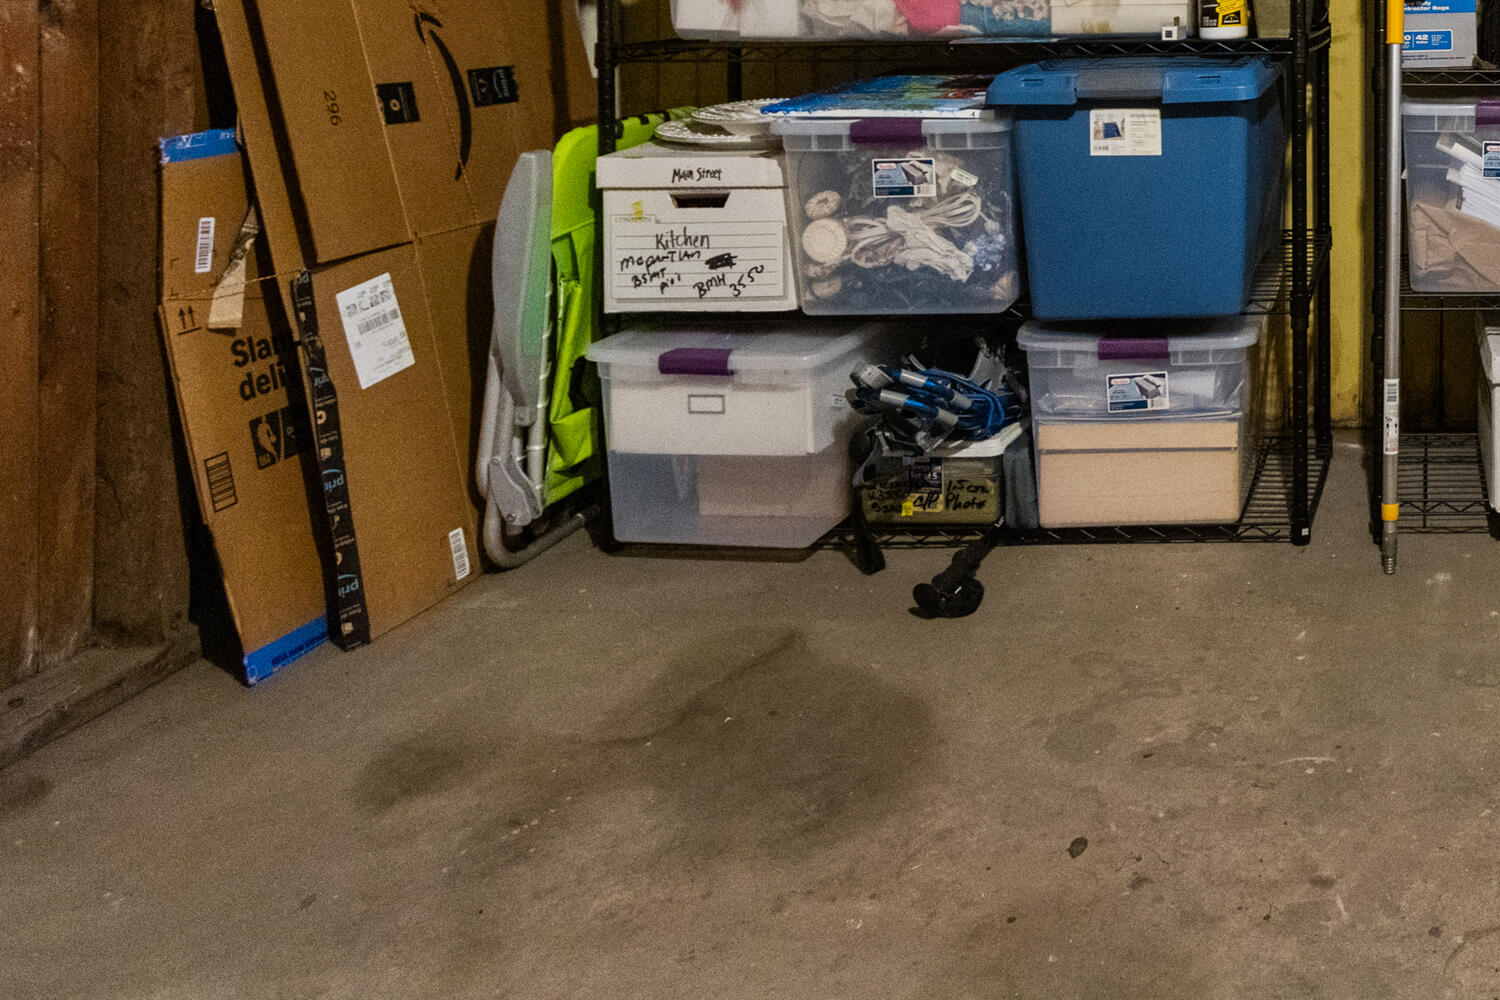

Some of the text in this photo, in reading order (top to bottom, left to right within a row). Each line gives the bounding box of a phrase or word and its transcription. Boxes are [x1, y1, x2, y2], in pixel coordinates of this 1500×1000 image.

[324, 89, 342, 127] 296
[672, 167, 722, 184] Main Street
[655, 227, 710, 250] Kitchen
[239, 362, 286, 402] deli
